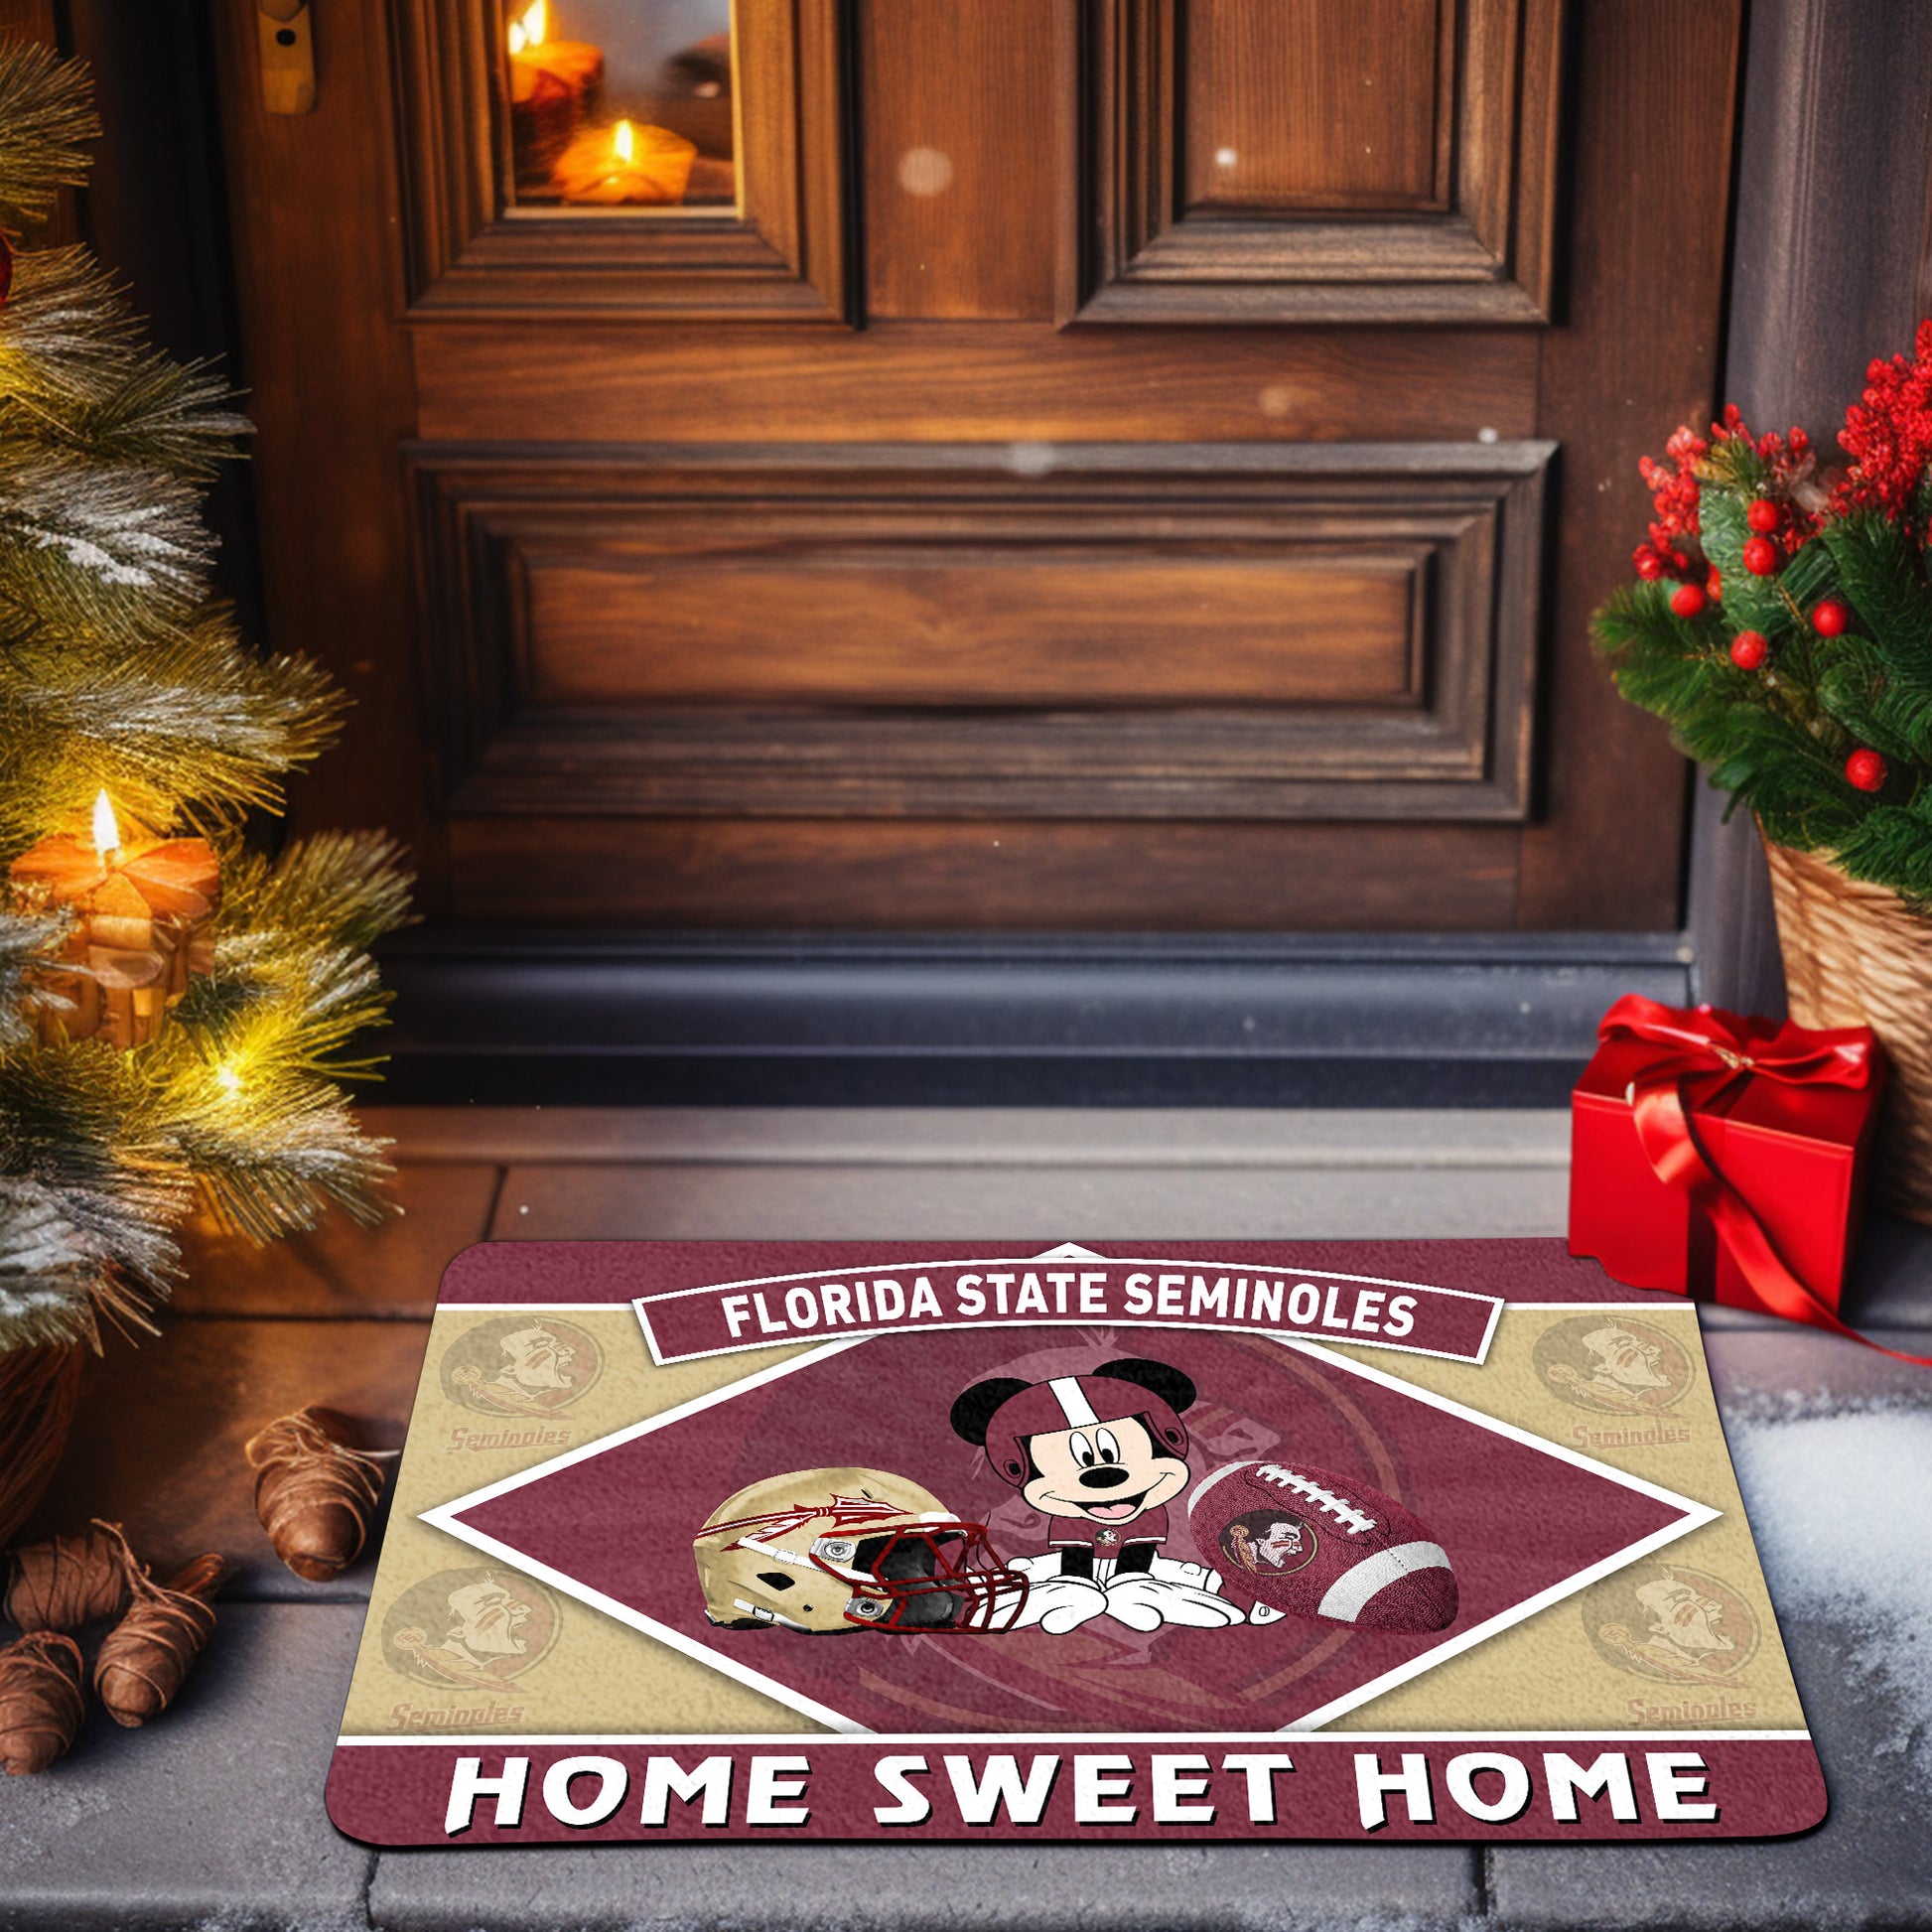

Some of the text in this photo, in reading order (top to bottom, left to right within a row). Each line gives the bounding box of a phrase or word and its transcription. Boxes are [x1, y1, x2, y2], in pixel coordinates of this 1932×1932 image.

[721, 1272, 1419, 1338] FLORIDA STATE SEMINOLES
[445, 1426, 573, 1452] Seminoles
[443, 1751, 1720, 1837] HOME SWEET HOME
